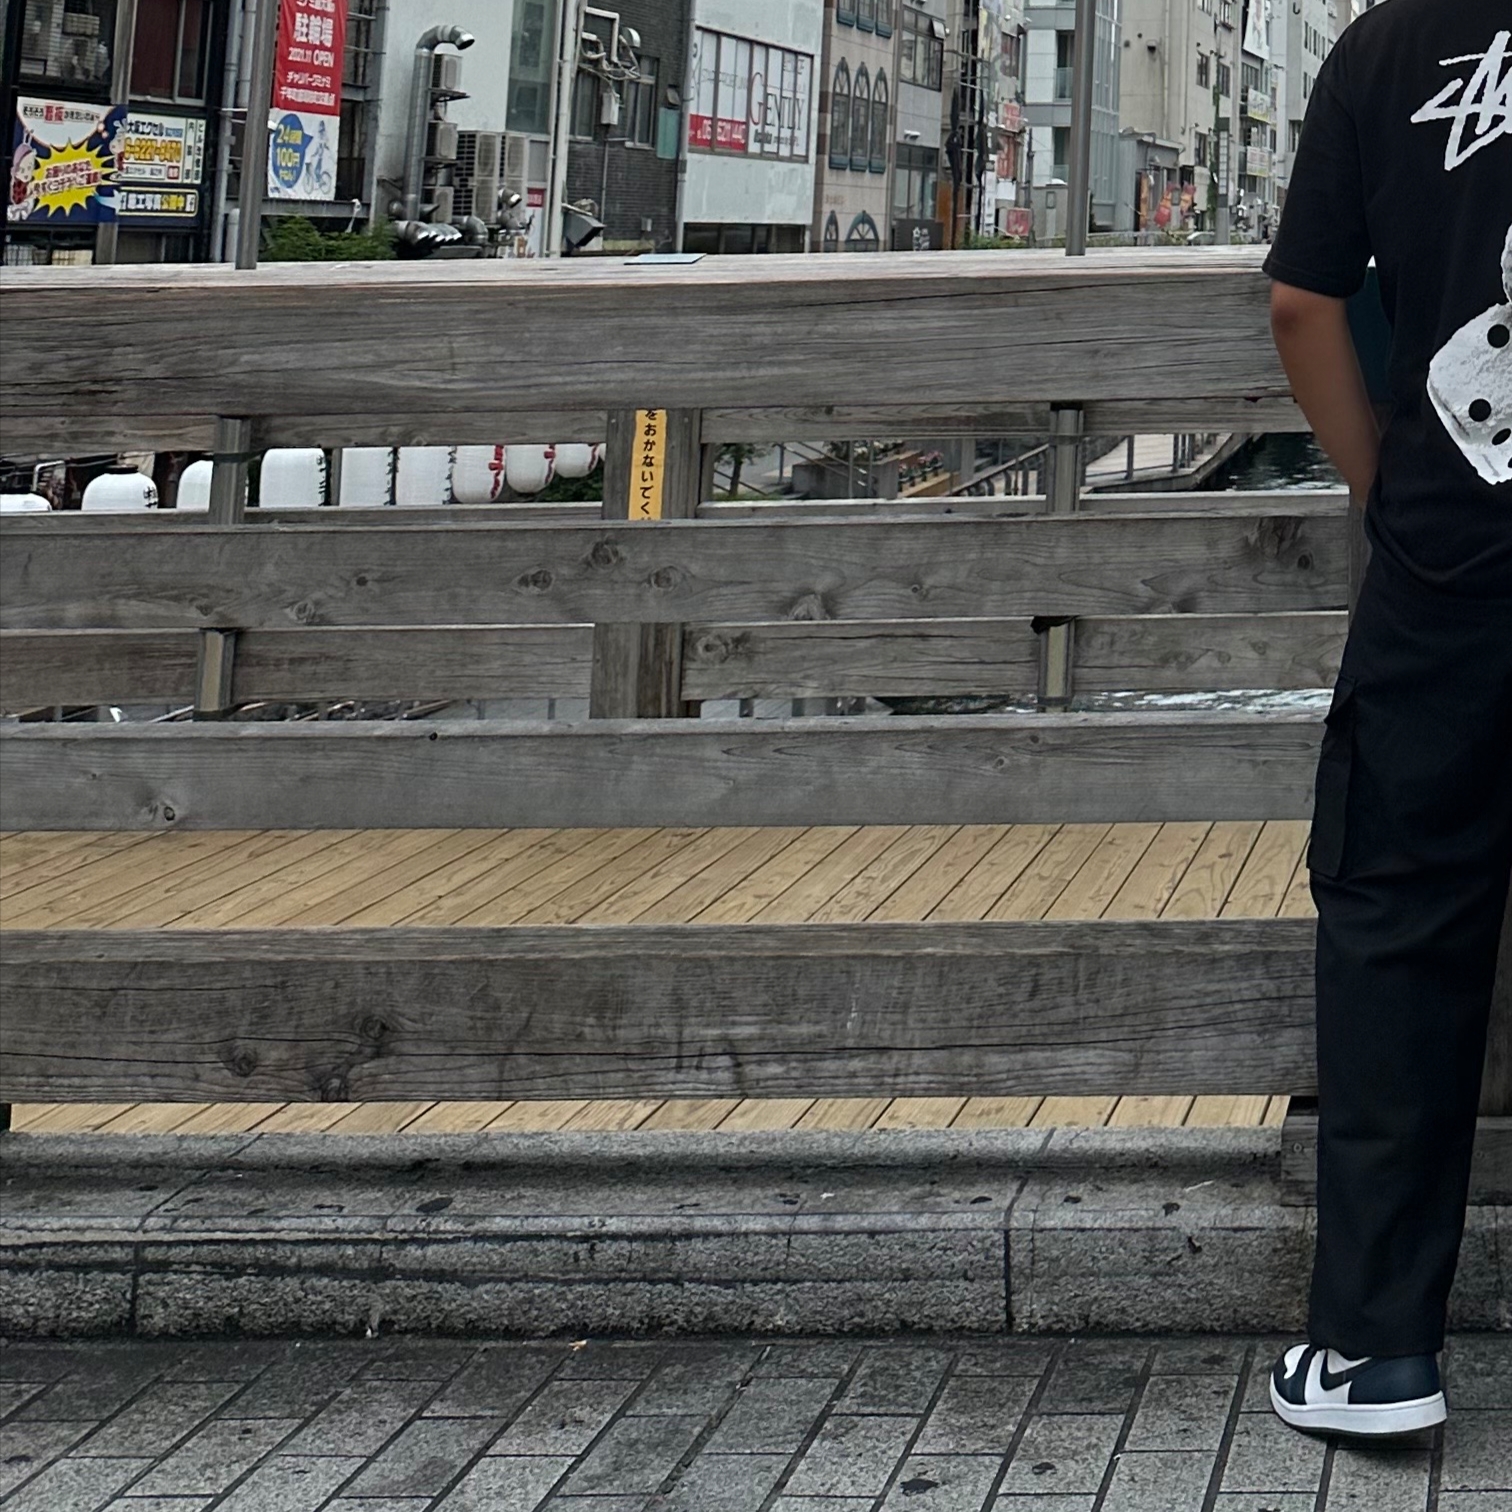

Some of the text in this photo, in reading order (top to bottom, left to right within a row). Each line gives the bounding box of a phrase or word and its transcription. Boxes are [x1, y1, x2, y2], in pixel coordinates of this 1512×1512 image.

[293, 12, 334, 48] 駐輪場
[313, 48, 335, 68] OPEN
